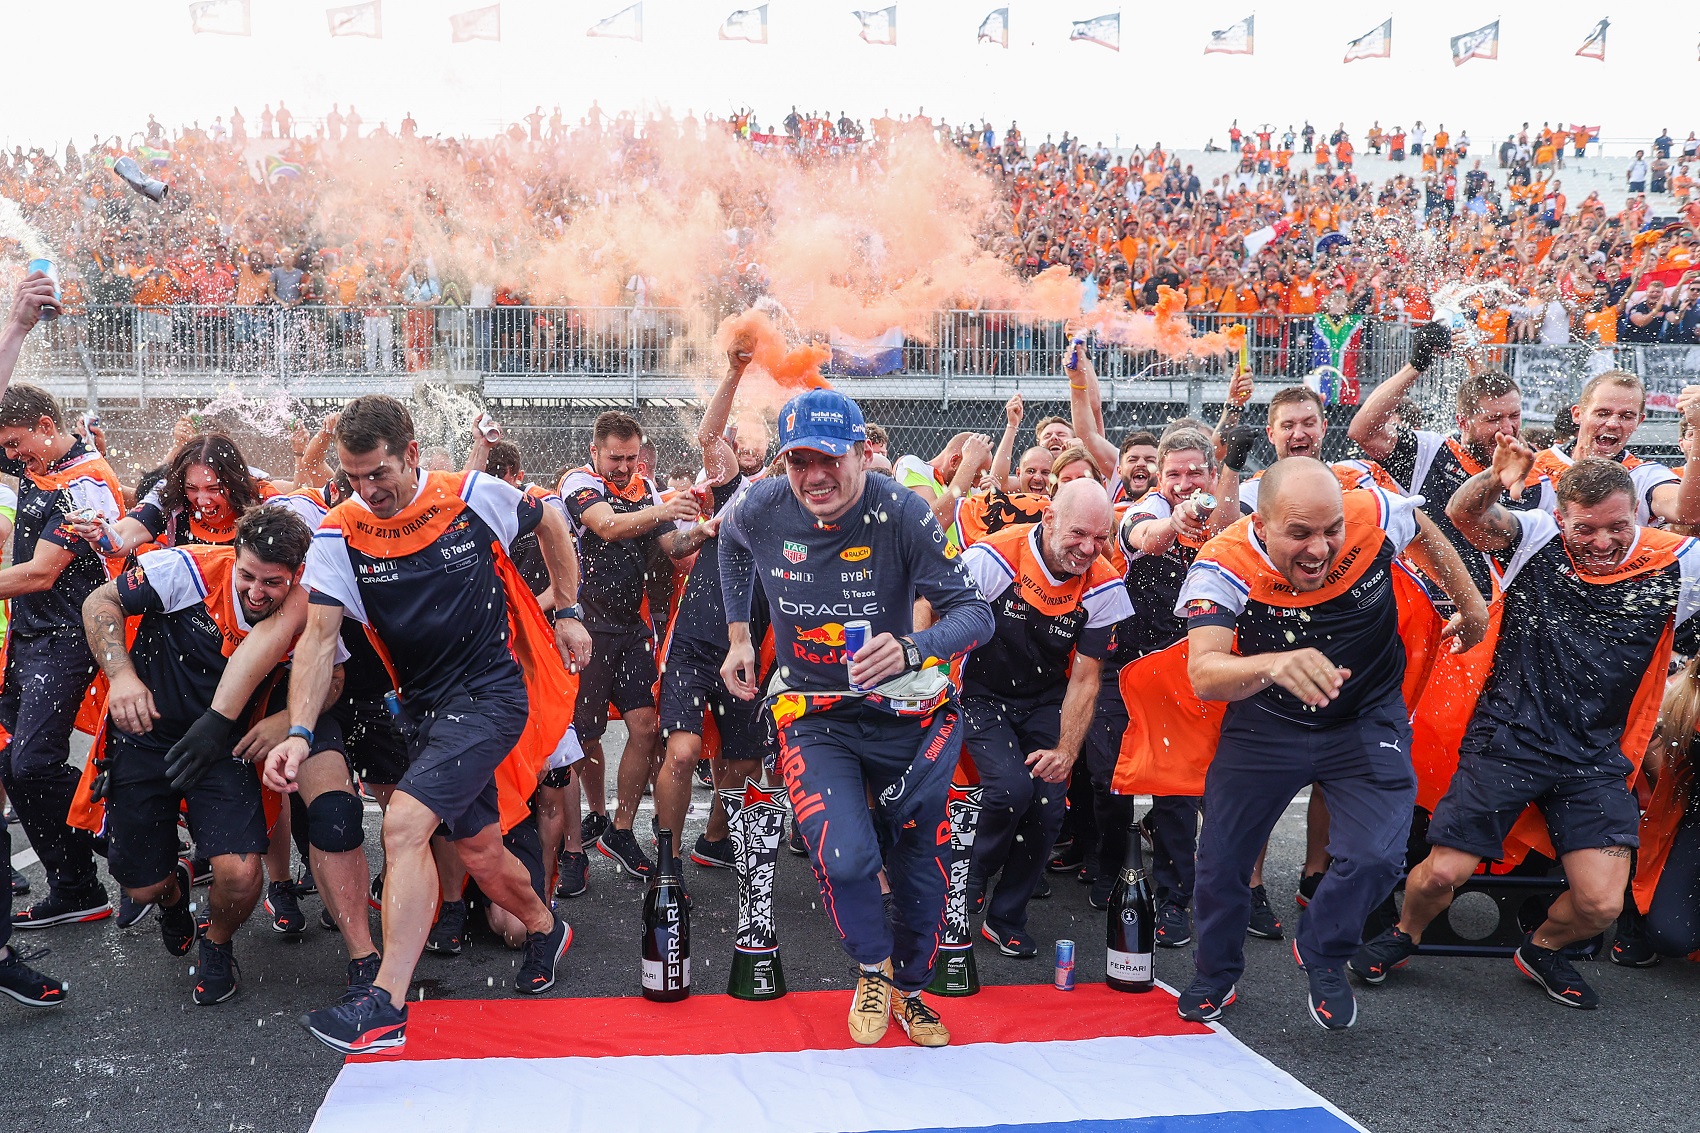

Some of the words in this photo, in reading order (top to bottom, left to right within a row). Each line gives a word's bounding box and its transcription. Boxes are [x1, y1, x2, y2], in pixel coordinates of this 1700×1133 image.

[786, 411, 796, 433] 1
[356, 520, 373, 535] WIJ
[375, 526, 401, 539] ZIJN
[401, 504, 441, 536] ORANJE
[450, 540, 475, 555] Tezos
[784, 549, 806, 561] HEUER
[787, 542, 806, 553] TAG
[848, 548, 869, 557] RAUCH
[359, 562, 386, 574] Mobil
[1326, 545, 1362, 585] ORANJE
[362, 573, 399, 584] ORACLE
[775, 567, 802, 581] Mobil
[841, 567, 873, 582] BYBIT
[1360, 568, 1385, 590] Tezos
[851, 590, 876, 598] Tezos
[1021, 574, 1037, 589] WIJ
[1046, 594, 1074, 606] ORANJE
[780, 602, 879, 616] ORACLE
[1005, 599, 1026, 612] Mobil
[1267, 606, 1297, 617] Mobil
[792, 642, 838, 665] Red
[938, 723, 955, 739] YOU
[924, 735, 947, 762] WINGS
[783, 753, 826, 824] Bull
[667, 902, 680, 992] FERRARI
[1110, 961, 1147, 972] FERRARI
